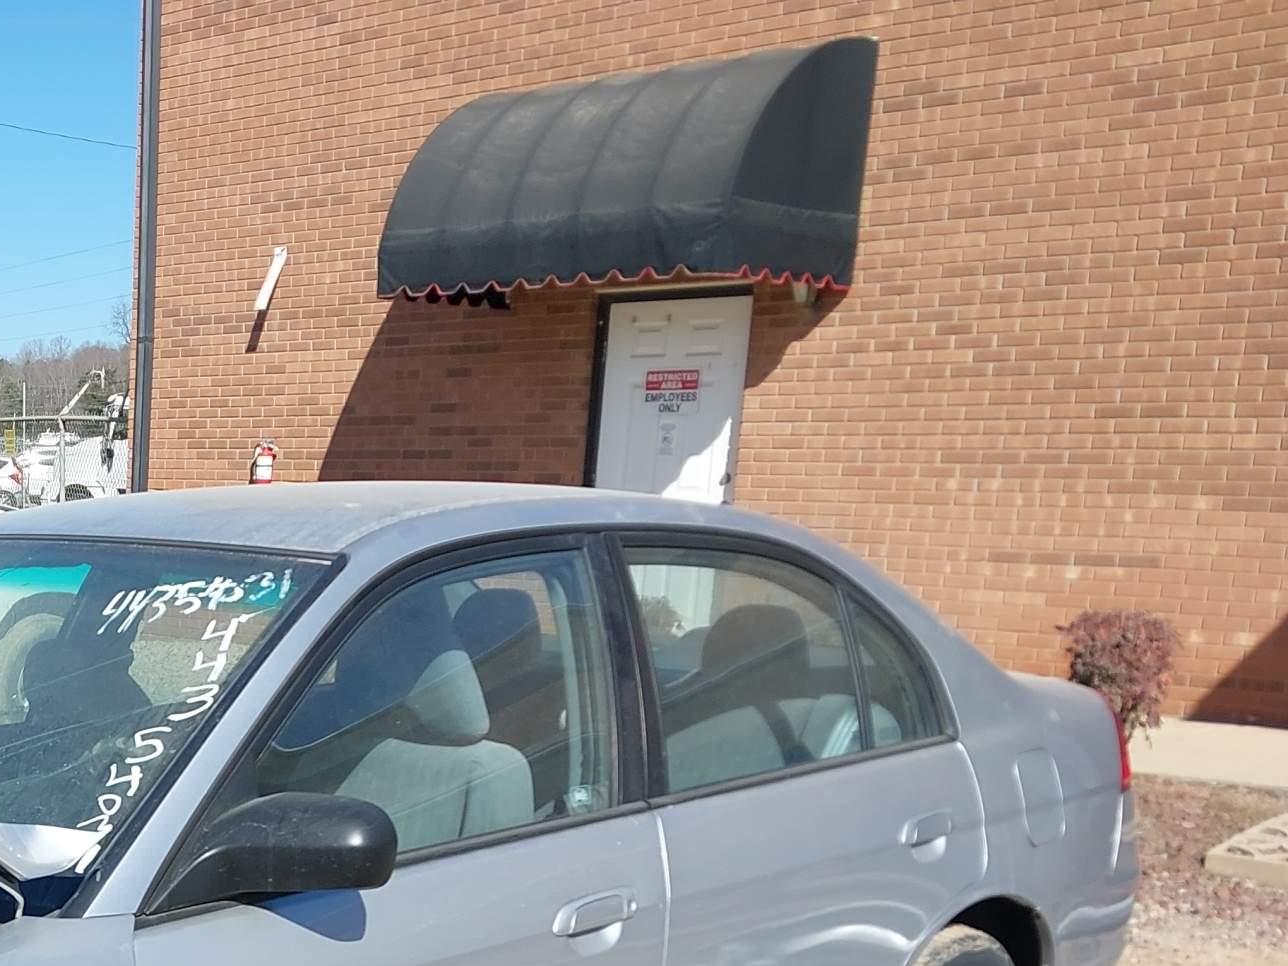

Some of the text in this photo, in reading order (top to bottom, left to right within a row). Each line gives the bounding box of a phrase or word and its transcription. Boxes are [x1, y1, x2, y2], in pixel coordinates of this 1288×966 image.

[647, 372, 698, 381] RESTRICTED
[660, 380, 683, 388] AREA
[645, 391, 698, 402] EMPLOYEES
[658, 403, 682, 412] ONLY
